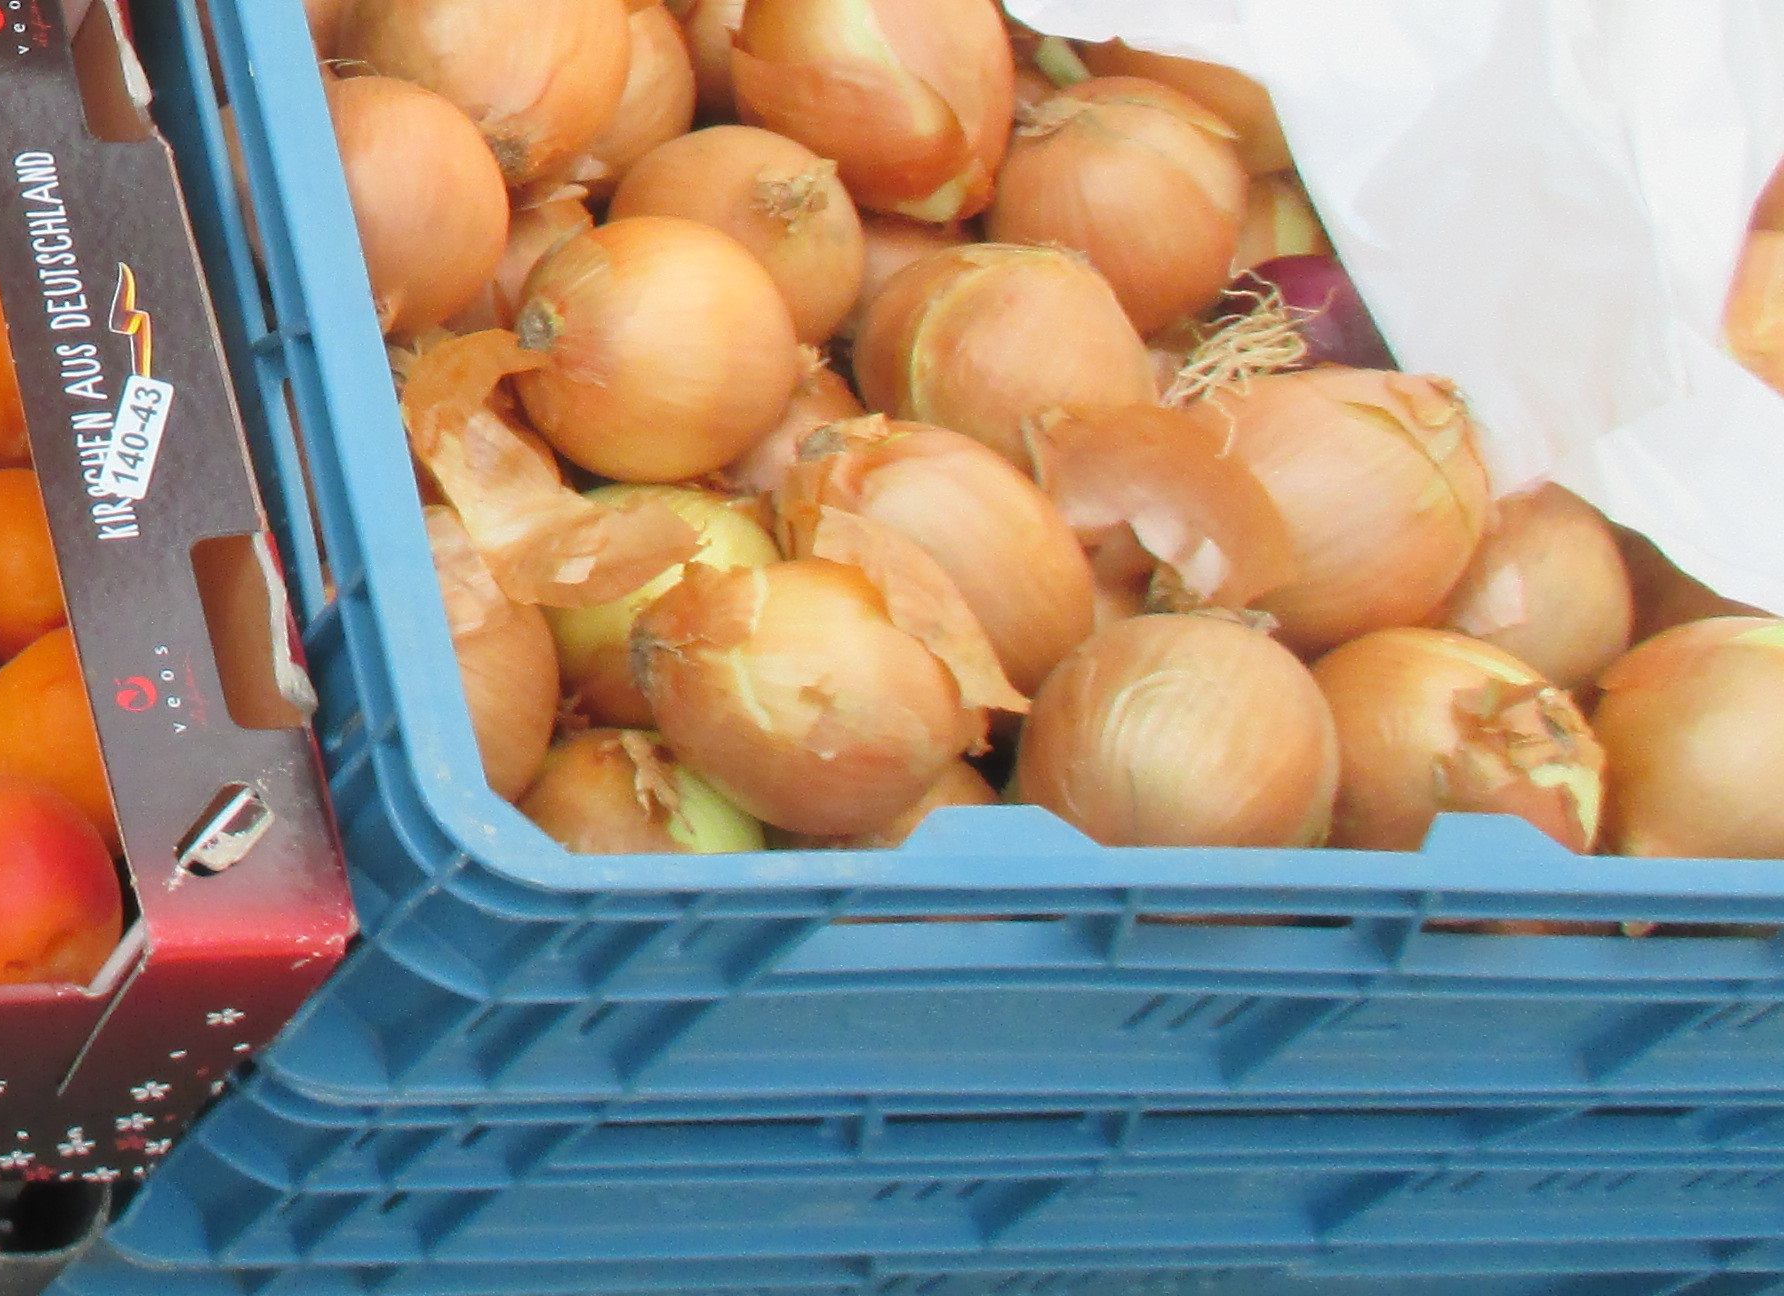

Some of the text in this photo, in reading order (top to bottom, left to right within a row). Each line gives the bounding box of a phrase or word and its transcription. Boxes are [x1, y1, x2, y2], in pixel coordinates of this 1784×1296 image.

[15, 150, 92, 331] DEUTSCHLAND
[55, 342, 109, 401] AUS
[110, 386, 162, 484] 140-43
[154, 645, 188, 734] veos
